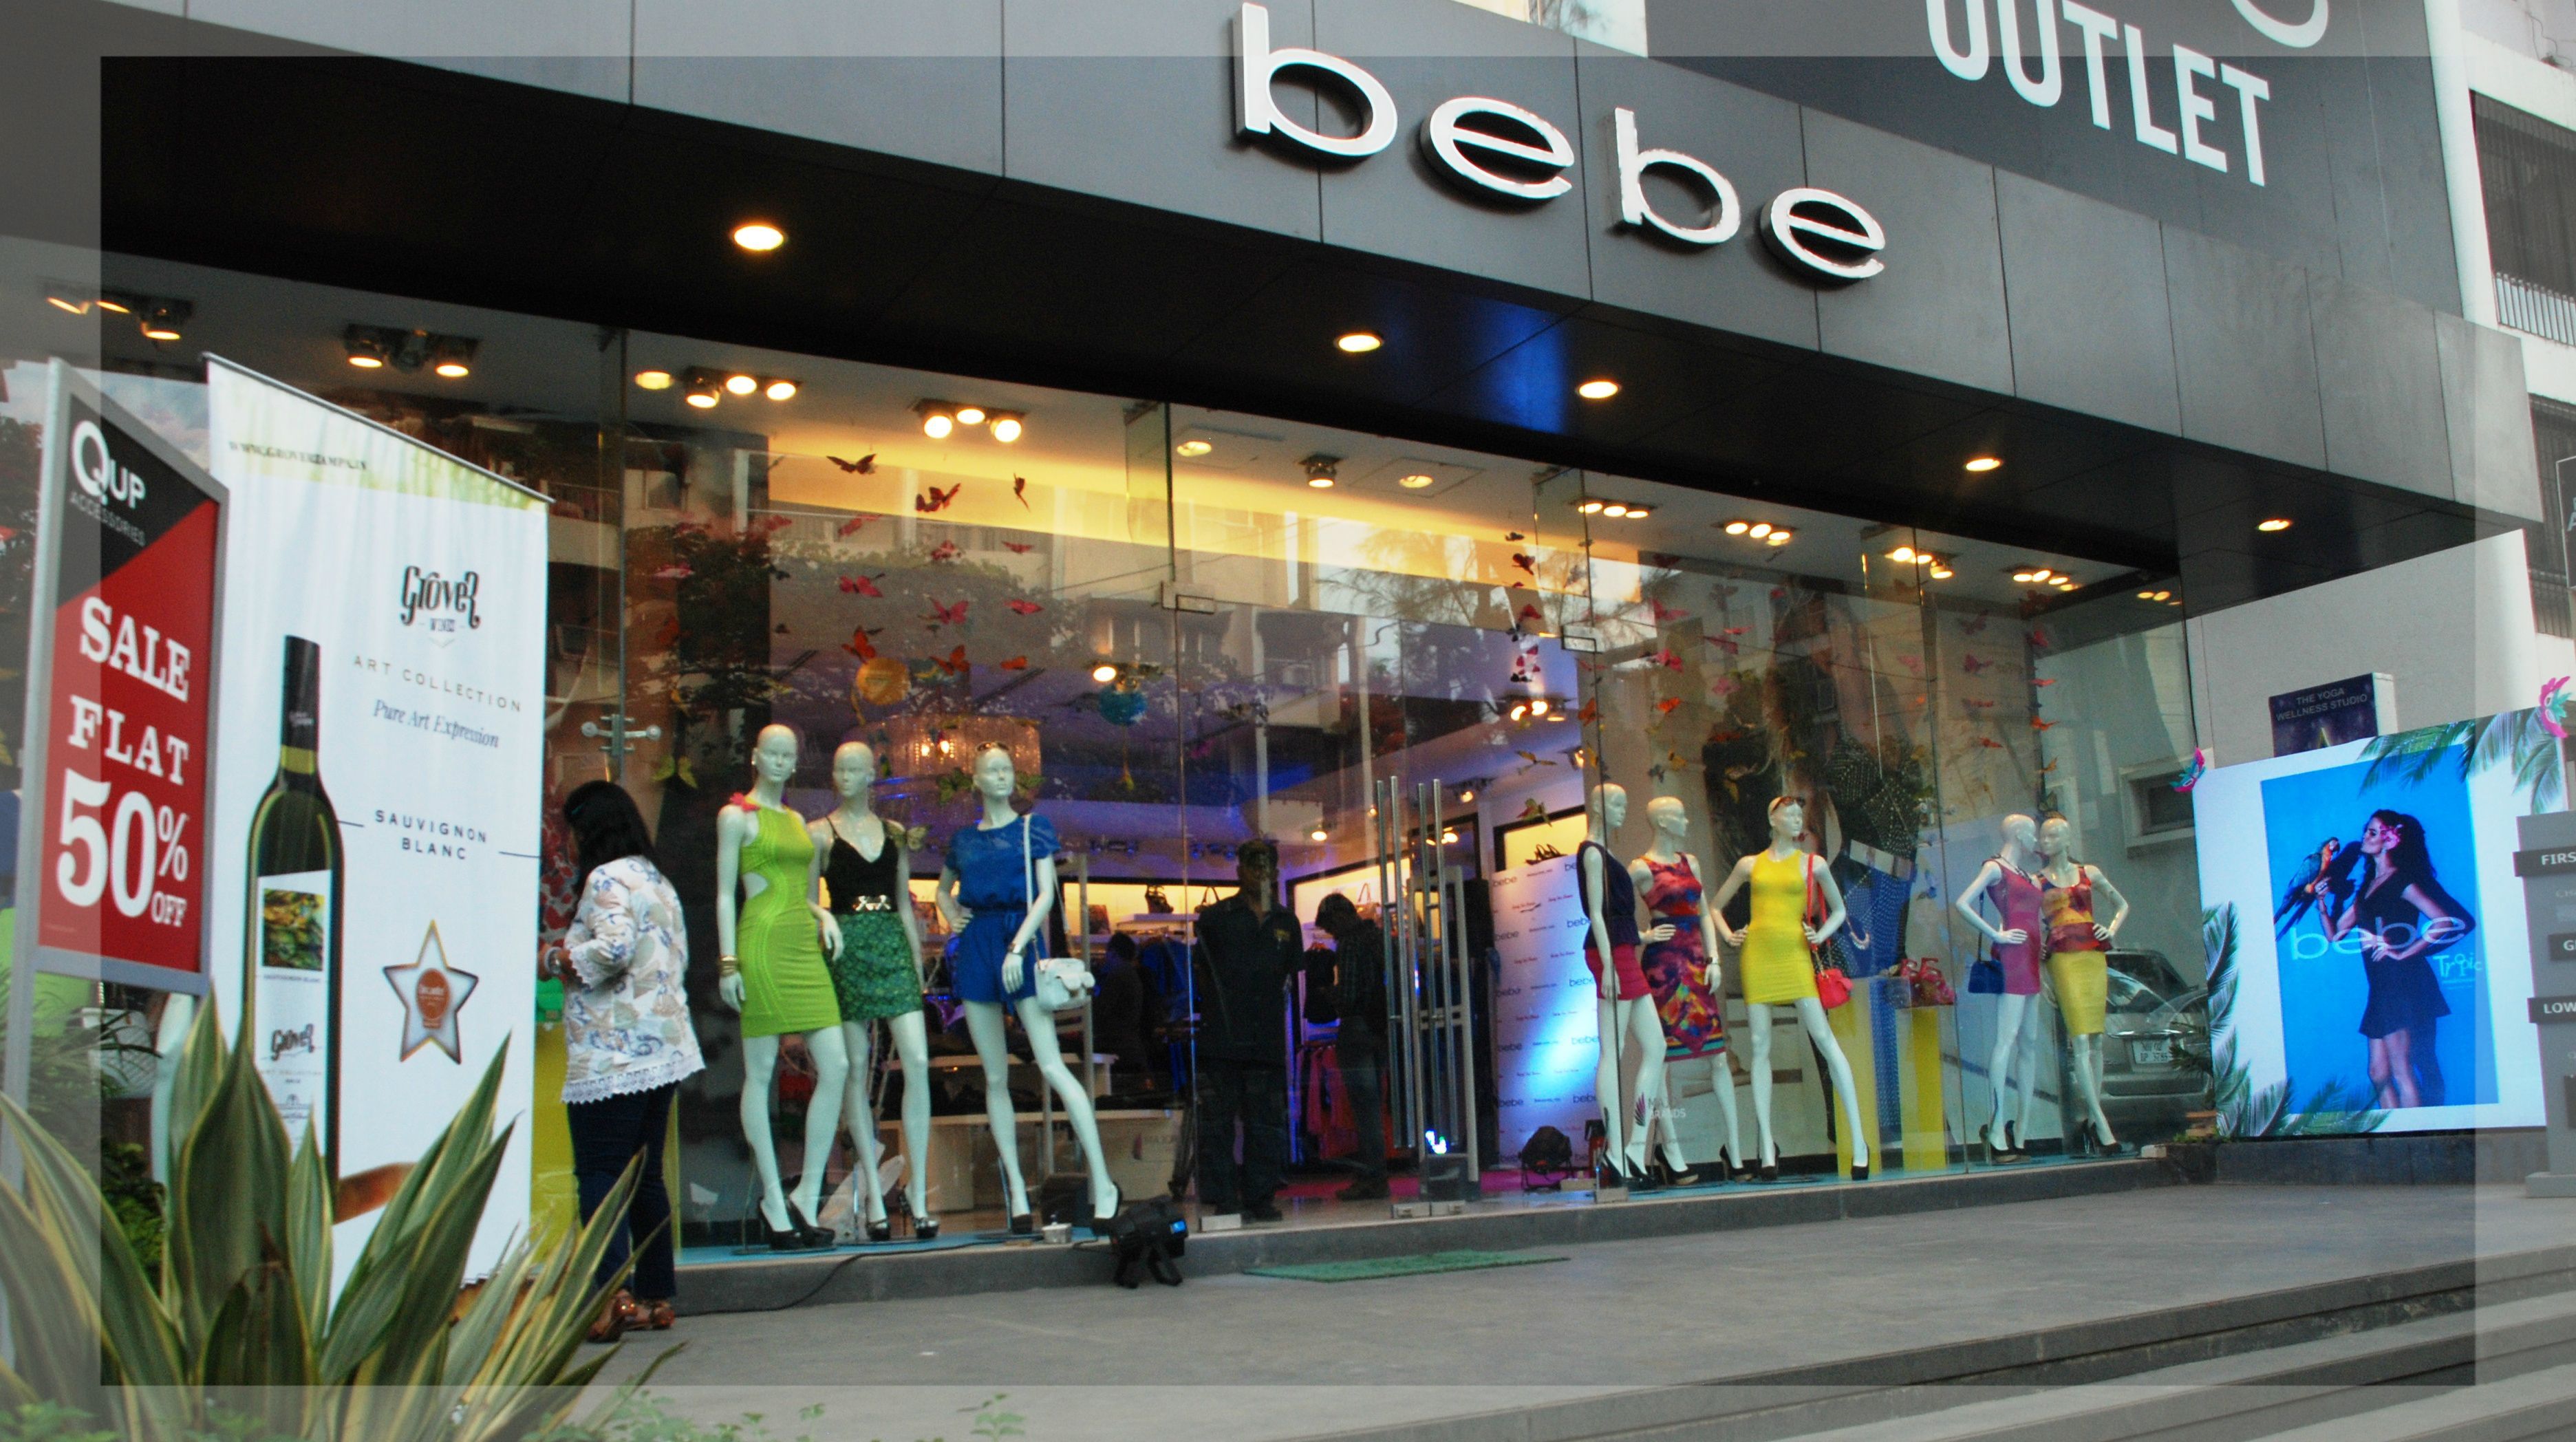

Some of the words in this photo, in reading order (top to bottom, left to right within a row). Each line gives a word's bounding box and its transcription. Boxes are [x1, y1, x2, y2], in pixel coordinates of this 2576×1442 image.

[1241, 3, 1886, 279] bebe
[80, 596, 190, 702] SALE
[354, 655, 391, 676] ART
[402, 669, 521, 712] COLLECTION
[2296, 695, 2316, 706] THE
[2317, 687, 2346, 700] YOGA
[373, 698, 406, 724] Pure
[407, 711, 431, 731] Art
[433, 714, 500, 749] Expression
[2275, 702, 2329, 722] WELLNESS
[2330, 693, 2368, 709] STUDIO
[68, 693, 189, 786] FLAT
[56, 767, 189, 918] 50%
[375, 809, 488, 843] SAUVIGNON
[402, 837, 467, 860] BLANC
[151, 890, 187, 927] OFF
[2290, 916, 2466, 960] bebe
